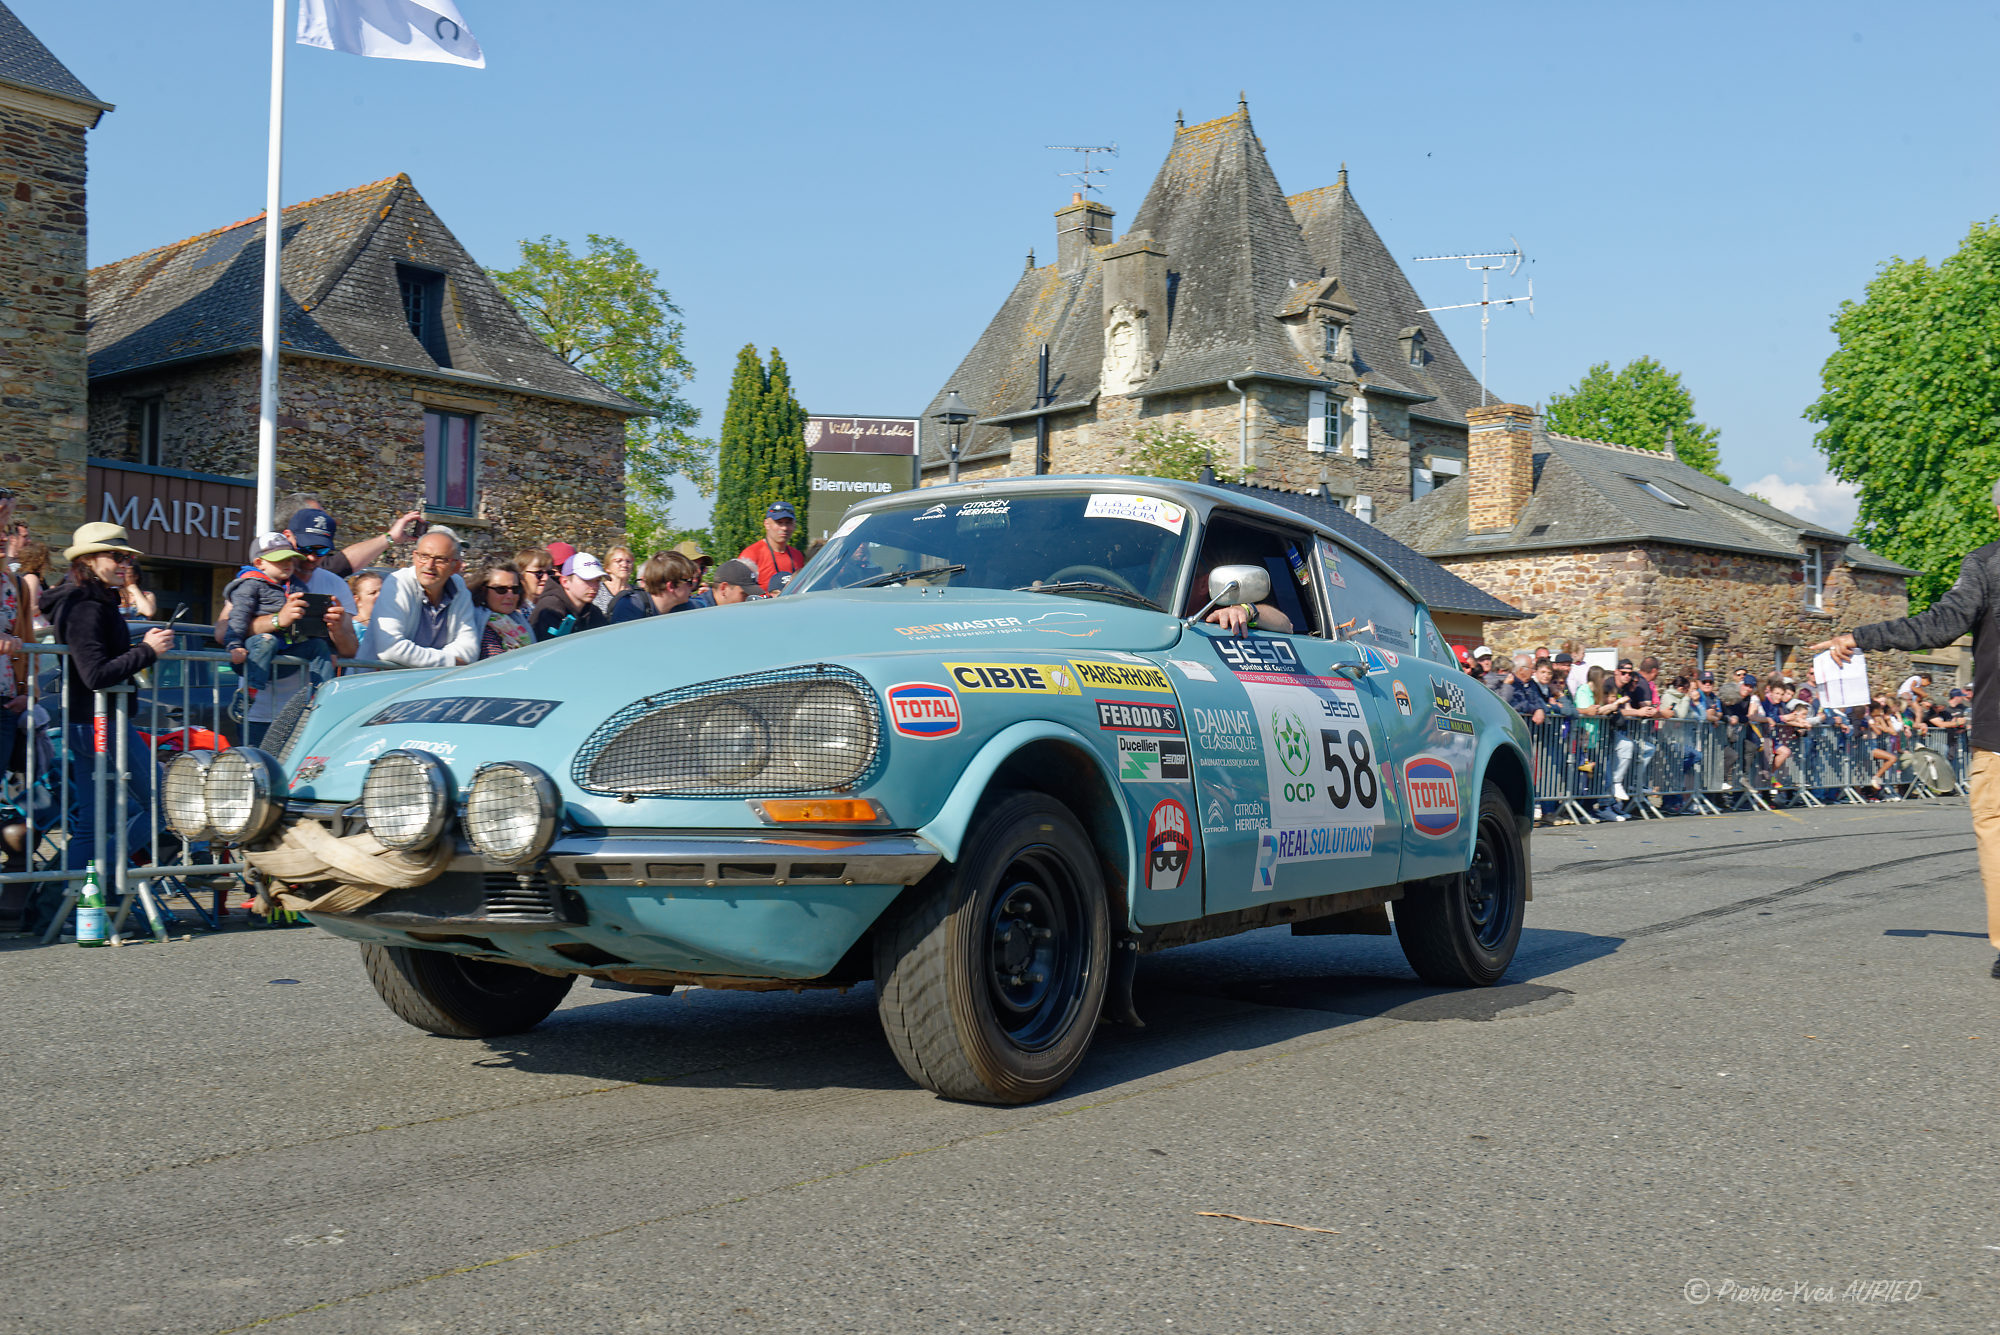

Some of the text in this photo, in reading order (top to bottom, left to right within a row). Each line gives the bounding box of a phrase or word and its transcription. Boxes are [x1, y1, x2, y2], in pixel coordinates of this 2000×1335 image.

[829, 422, 864, 439] Village
[866, 424, 879, 435] de
[812, 477, 892, 493] Bienvenue
[956, 507, 1010, 517] HERITAGE
[963, 499, 1010, 509] CITROËN
[101, 491, 241, 541] MAIRIE
[894, 617, 1022, 635] DENTMASTER
[1216, 640, 1297, 664] YESO
[490, 700, 551, 725] 78
[896, 699, 956, 719] TOTAL
[1100, 704, 1162, 728] FERODO
[1320, 700, 1360, 719] YESO
[1193, 708, 1252, 735] DAUNAT
[1119, 737, 1158, 751] Ducellier
[1200, 732, 1257, 752] CLASSIQUE
[1320, 728, 1378, 809] 58
[1283, 783, 1315, 802] OCP
[1411, 782, 1455, 808] TOTAL
[1234, 801, 1264, 816] CITROËN
[1154, 805, 1185, 837] XAS
[1235, 817, 1269, 832] HERITAGE
[1151, 829, 1190, 851] MICHELIN
